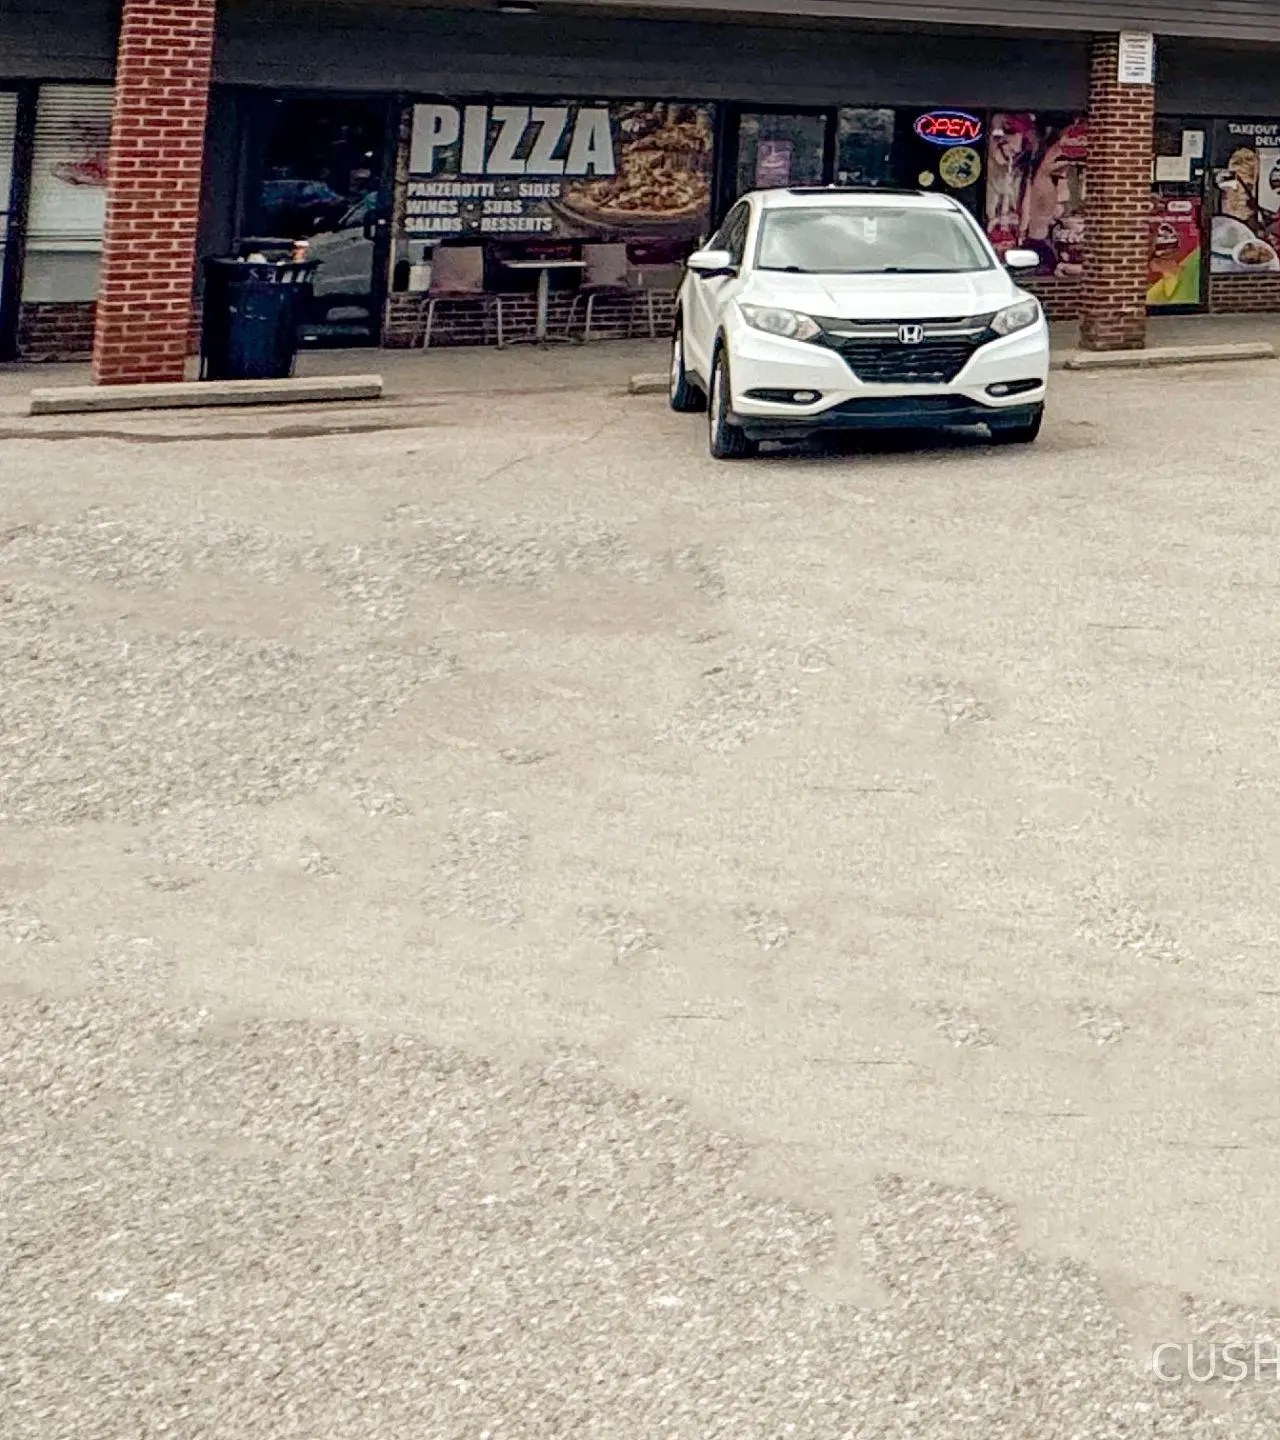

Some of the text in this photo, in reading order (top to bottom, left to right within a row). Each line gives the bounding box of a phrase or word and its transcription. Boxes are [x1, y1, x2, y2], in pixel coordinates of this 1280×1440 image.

[916, 115, 982, 138] OPEN
[1228, 123, 1279, 135] TAKEOUT
[408, 103, 617, 176] PIZZA
[518, 183, 561, 197] SIDES
[406, 200, 522, 214] WINGS SUBS
[404, 217, 553, 232] SALADS DESSERTS
